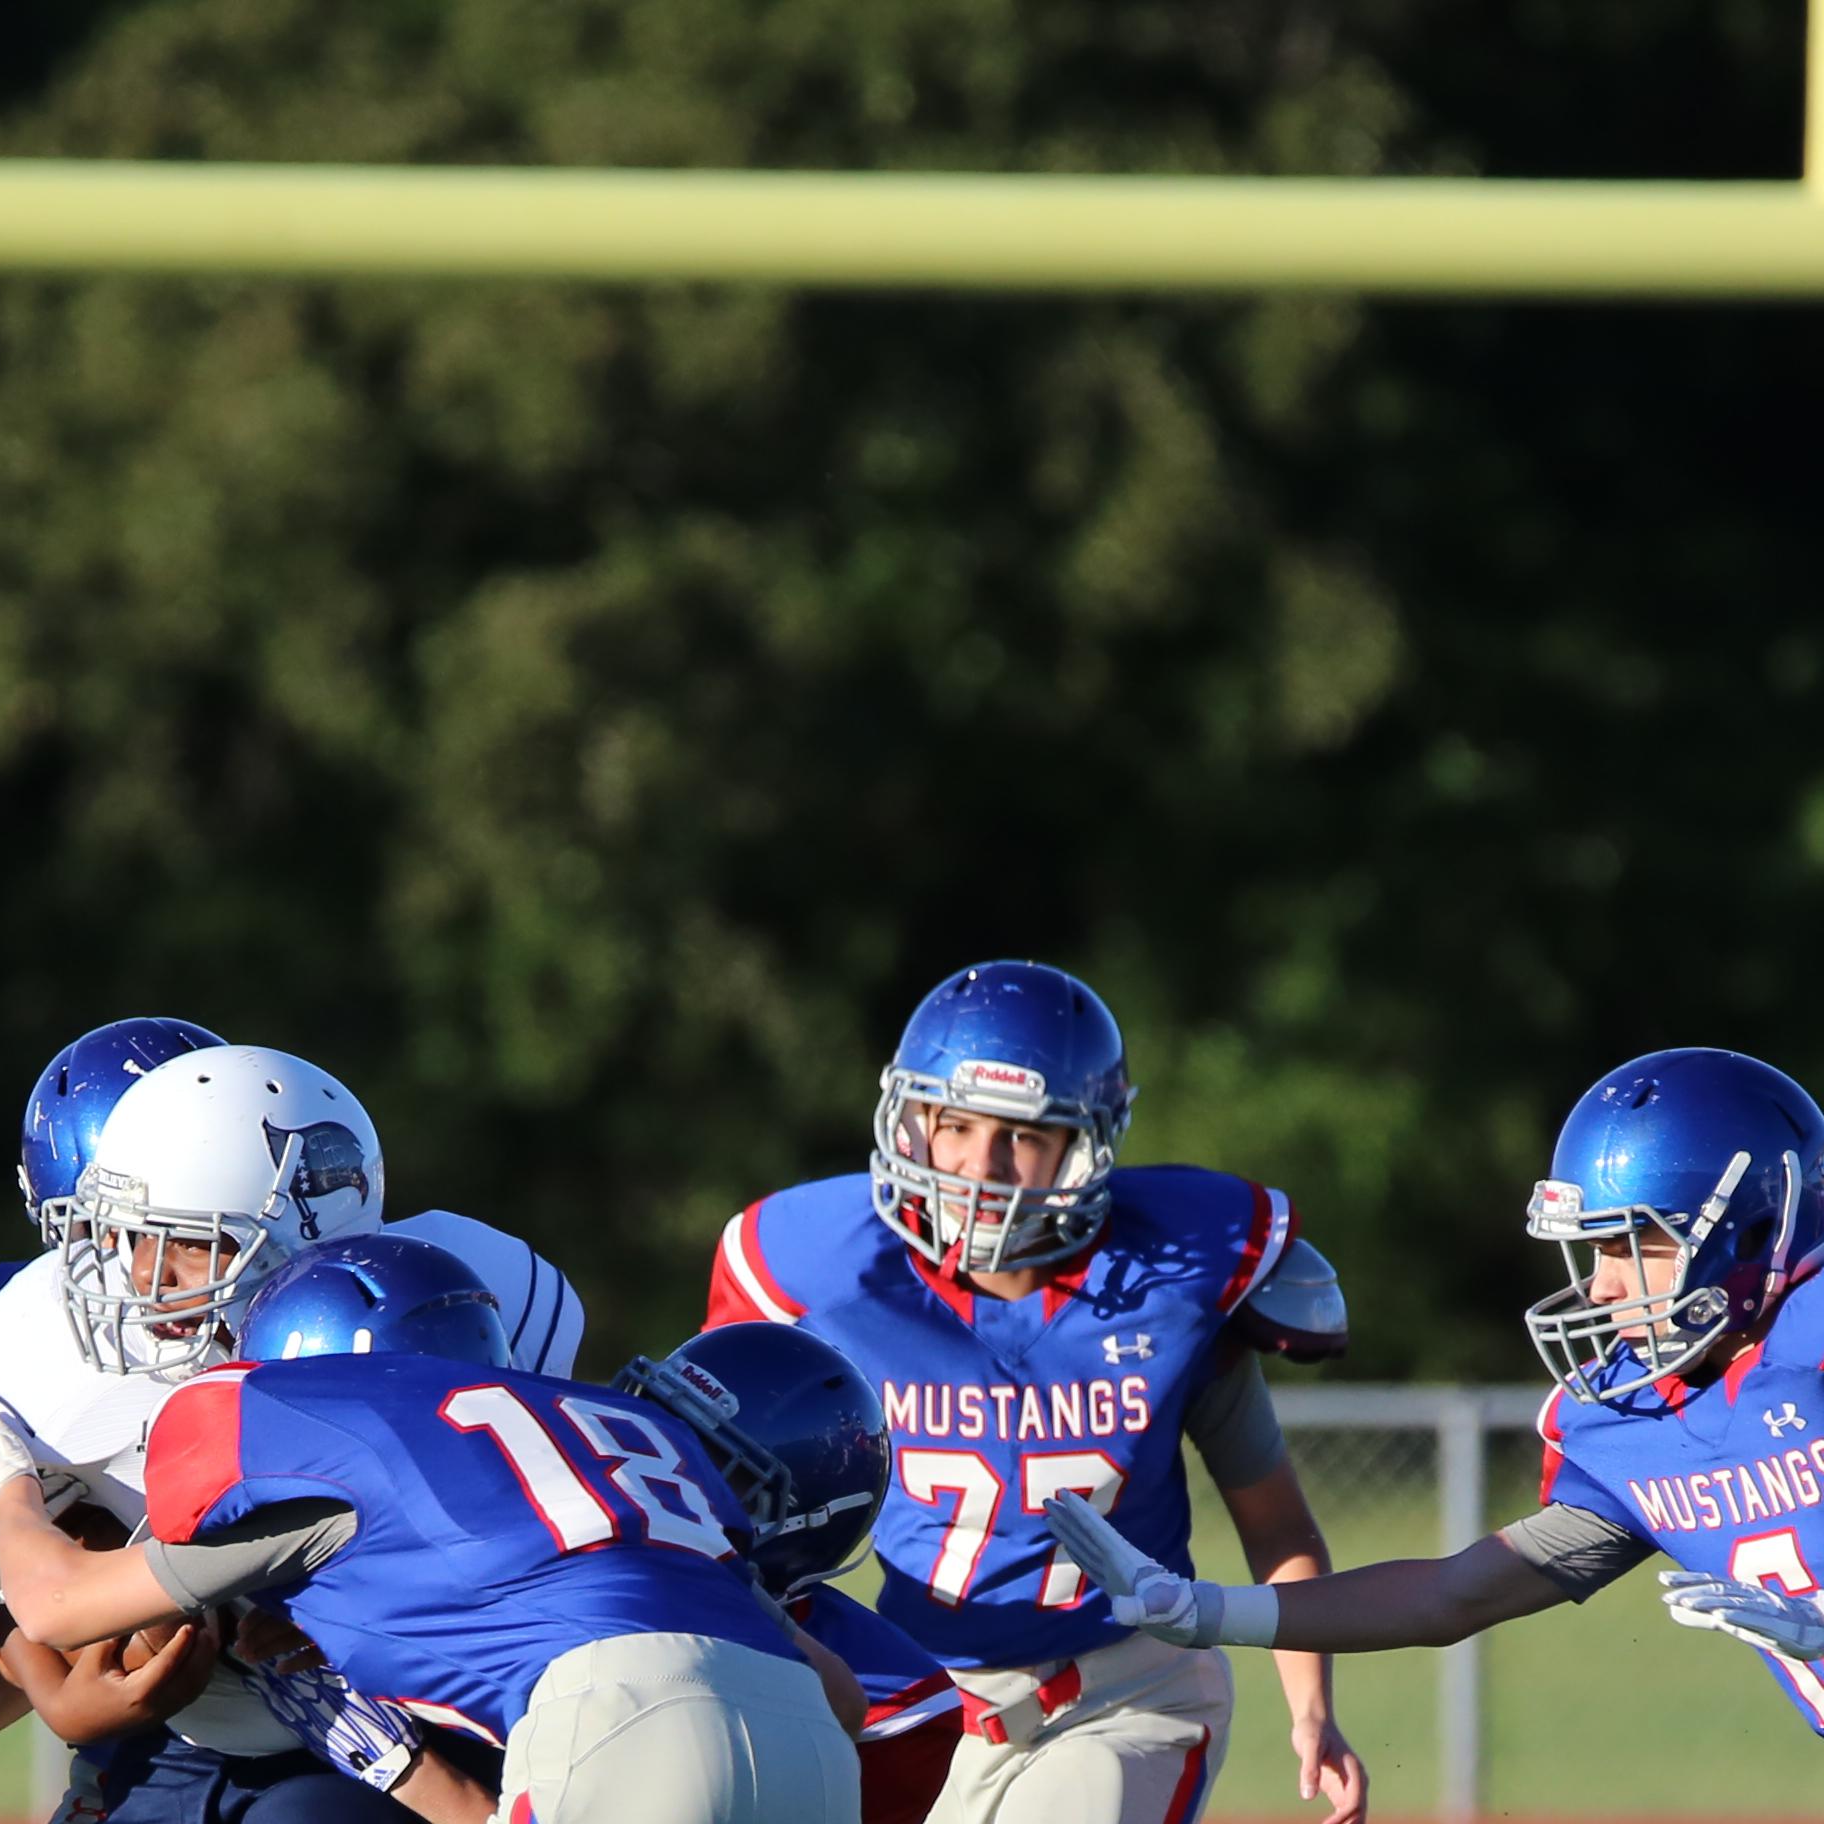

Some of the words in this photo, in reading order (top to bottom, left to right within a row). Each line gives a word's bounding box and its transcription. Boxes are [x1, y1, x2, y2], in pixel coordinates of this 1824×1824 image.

[974, 1065, 1027, 1086] Riddell
[680, 1364, 724, 1400] Riddell
[881, 1374, 1152, 1441] MUSTANGS
[436, 1382, 740, 1562] 18
[897, 1447, 1130, 1613] 77
